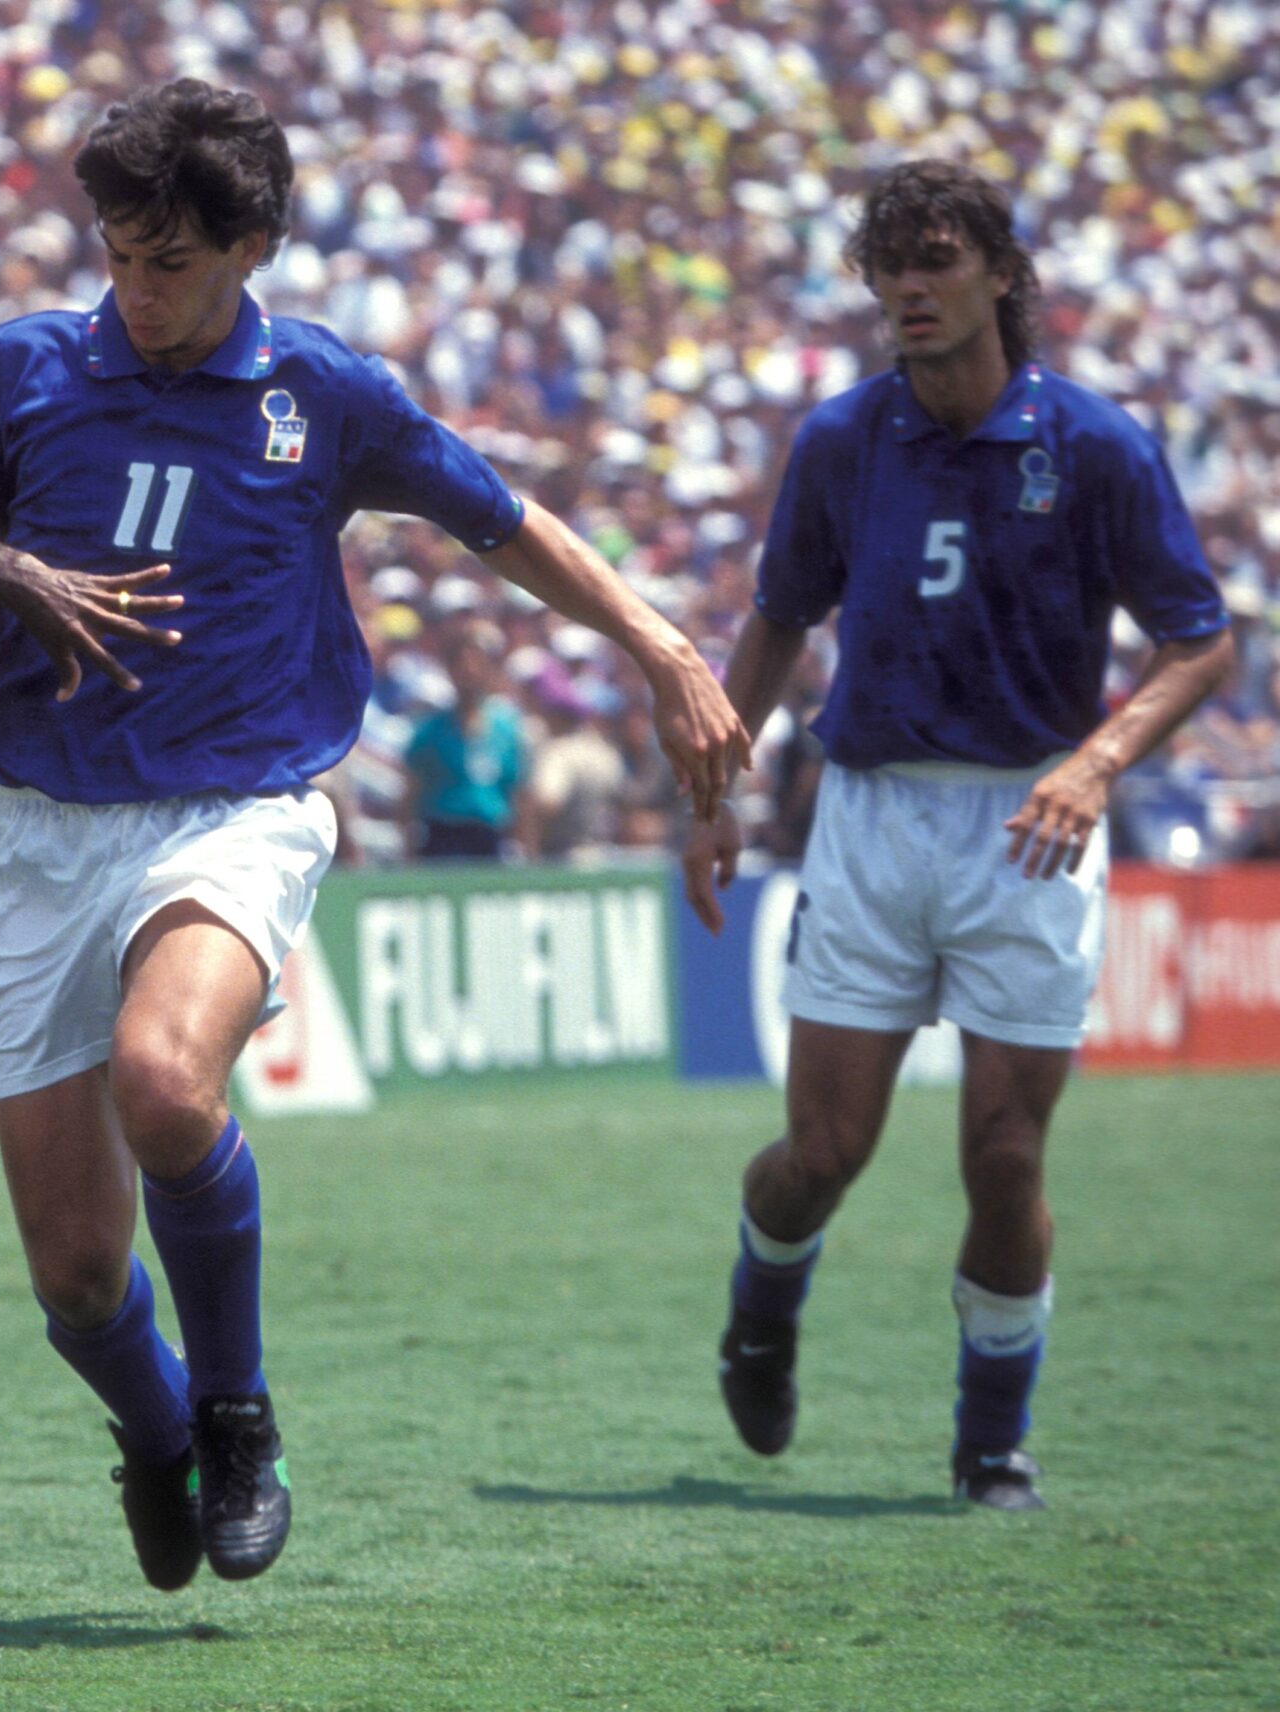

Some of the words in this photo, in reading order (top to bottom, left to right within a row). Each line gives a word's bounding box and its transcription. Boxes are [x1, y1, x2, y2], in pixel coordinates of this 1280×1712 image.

[113, 461, 199, 557] 11
[918, 520, 968, 599] 5
[360, 888, 667, 1076] FUJIFILM
